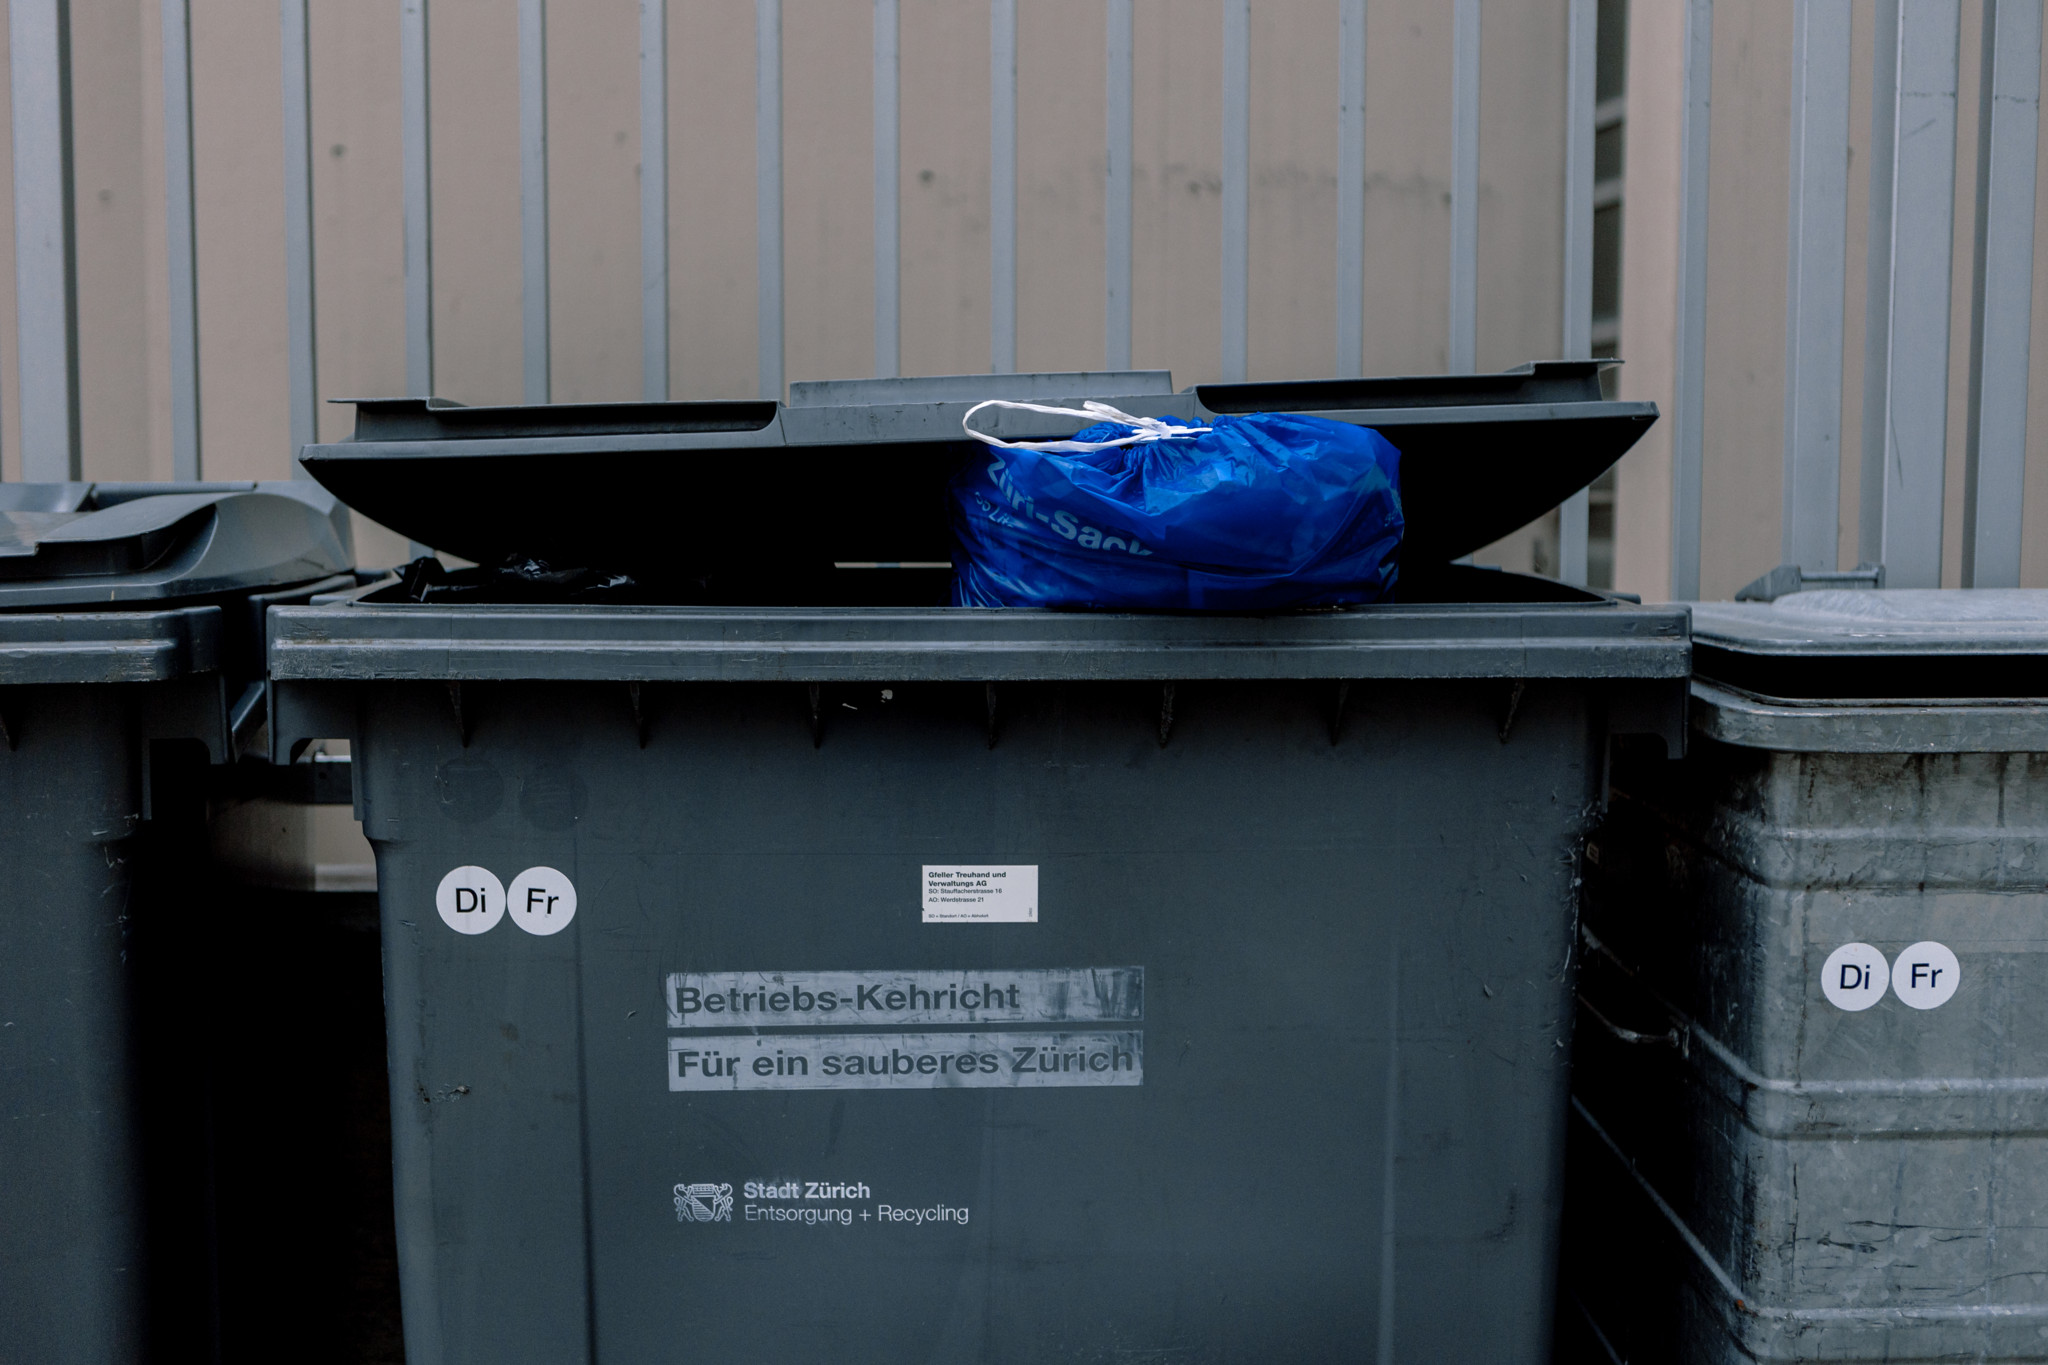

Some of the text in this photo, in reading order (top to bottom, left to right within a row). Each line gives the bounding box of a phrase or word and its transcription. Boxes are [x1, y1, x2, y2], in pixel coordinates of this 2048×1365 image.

[456, 887, 560, 914] Di Fr
[1840, 963, 1943, 990] Di Fr
[676, 983, 1021, 1014] Betriebs-Kehricht
[678, 1045, 1133, 1077] Für ein sauberes Zürich
[743, 1182, 871, 1199] Stadt Zürich
[744, 1203, 969, 1225] Entsorgung + Recycling
